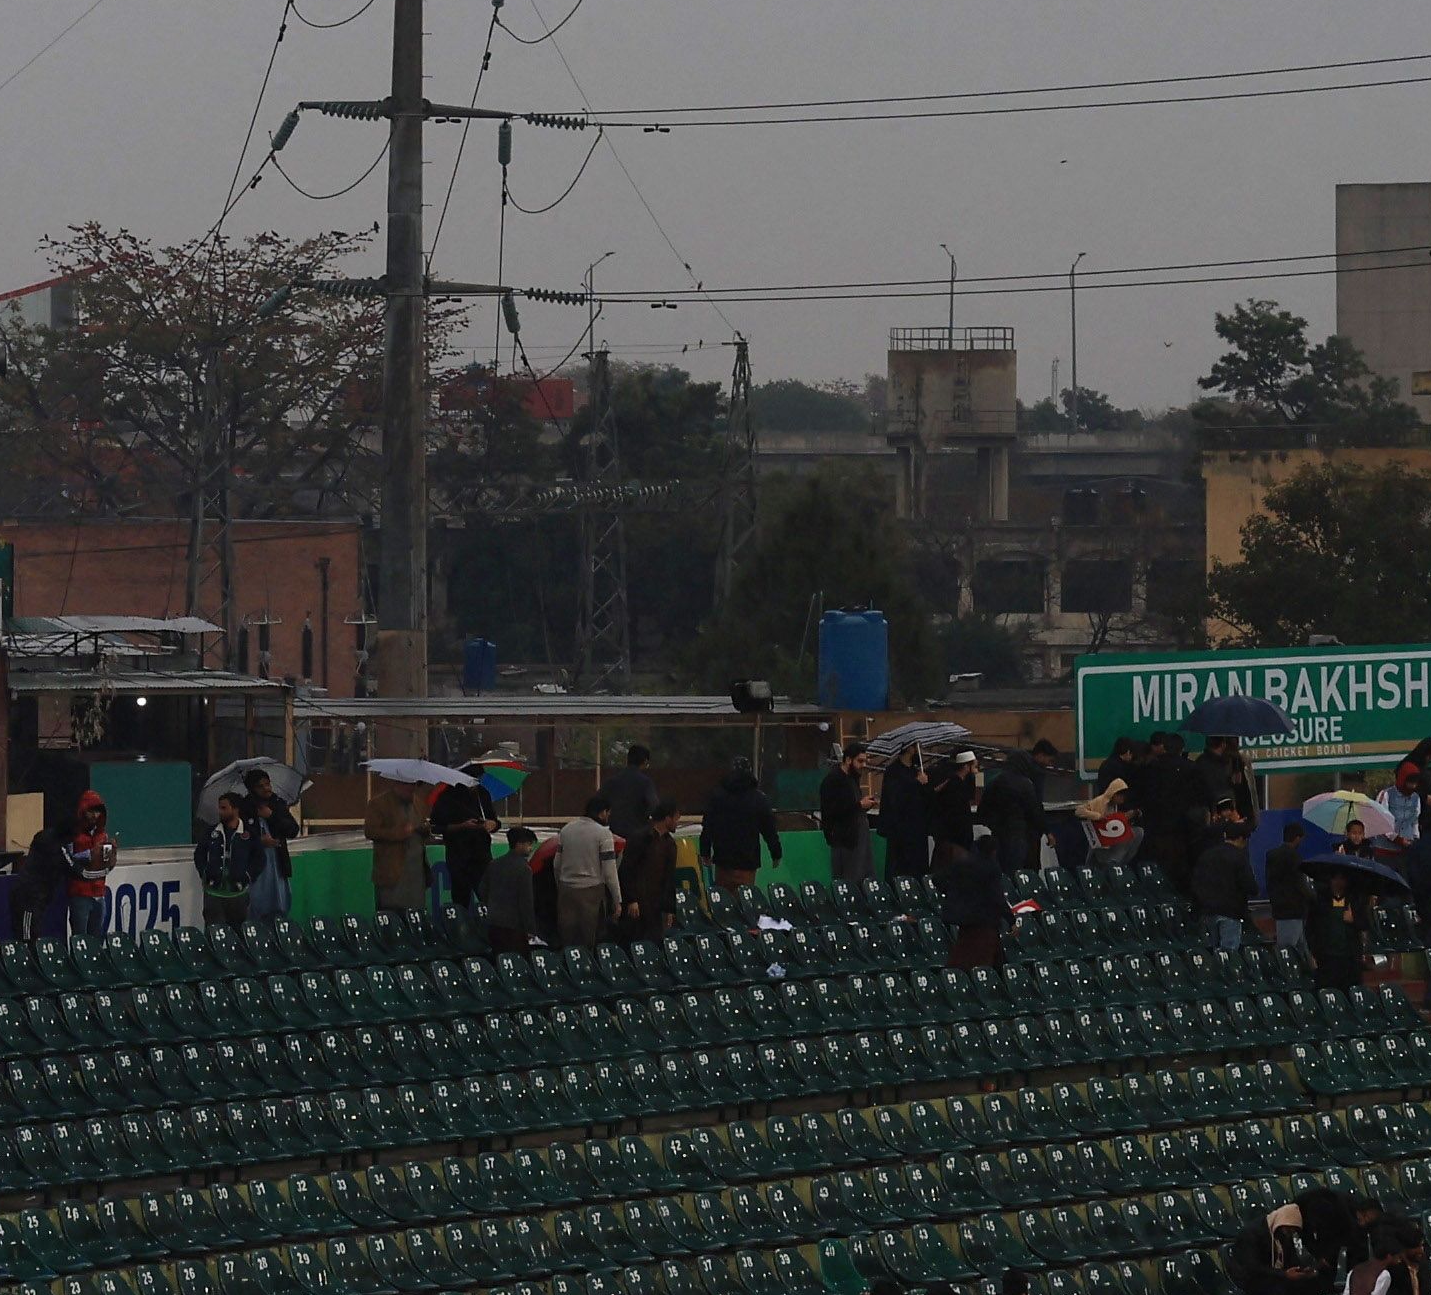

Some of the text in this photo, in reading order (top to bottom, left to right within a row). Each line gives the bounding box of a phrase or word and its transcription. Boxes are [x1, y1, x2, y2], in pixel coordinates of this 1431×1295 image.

[1132, 662, 1429, 723] MIRAN BAKHSH
[1265, 745, 1308, 757] CRICKET
[1317, 743, 1352, 755] BOARD
